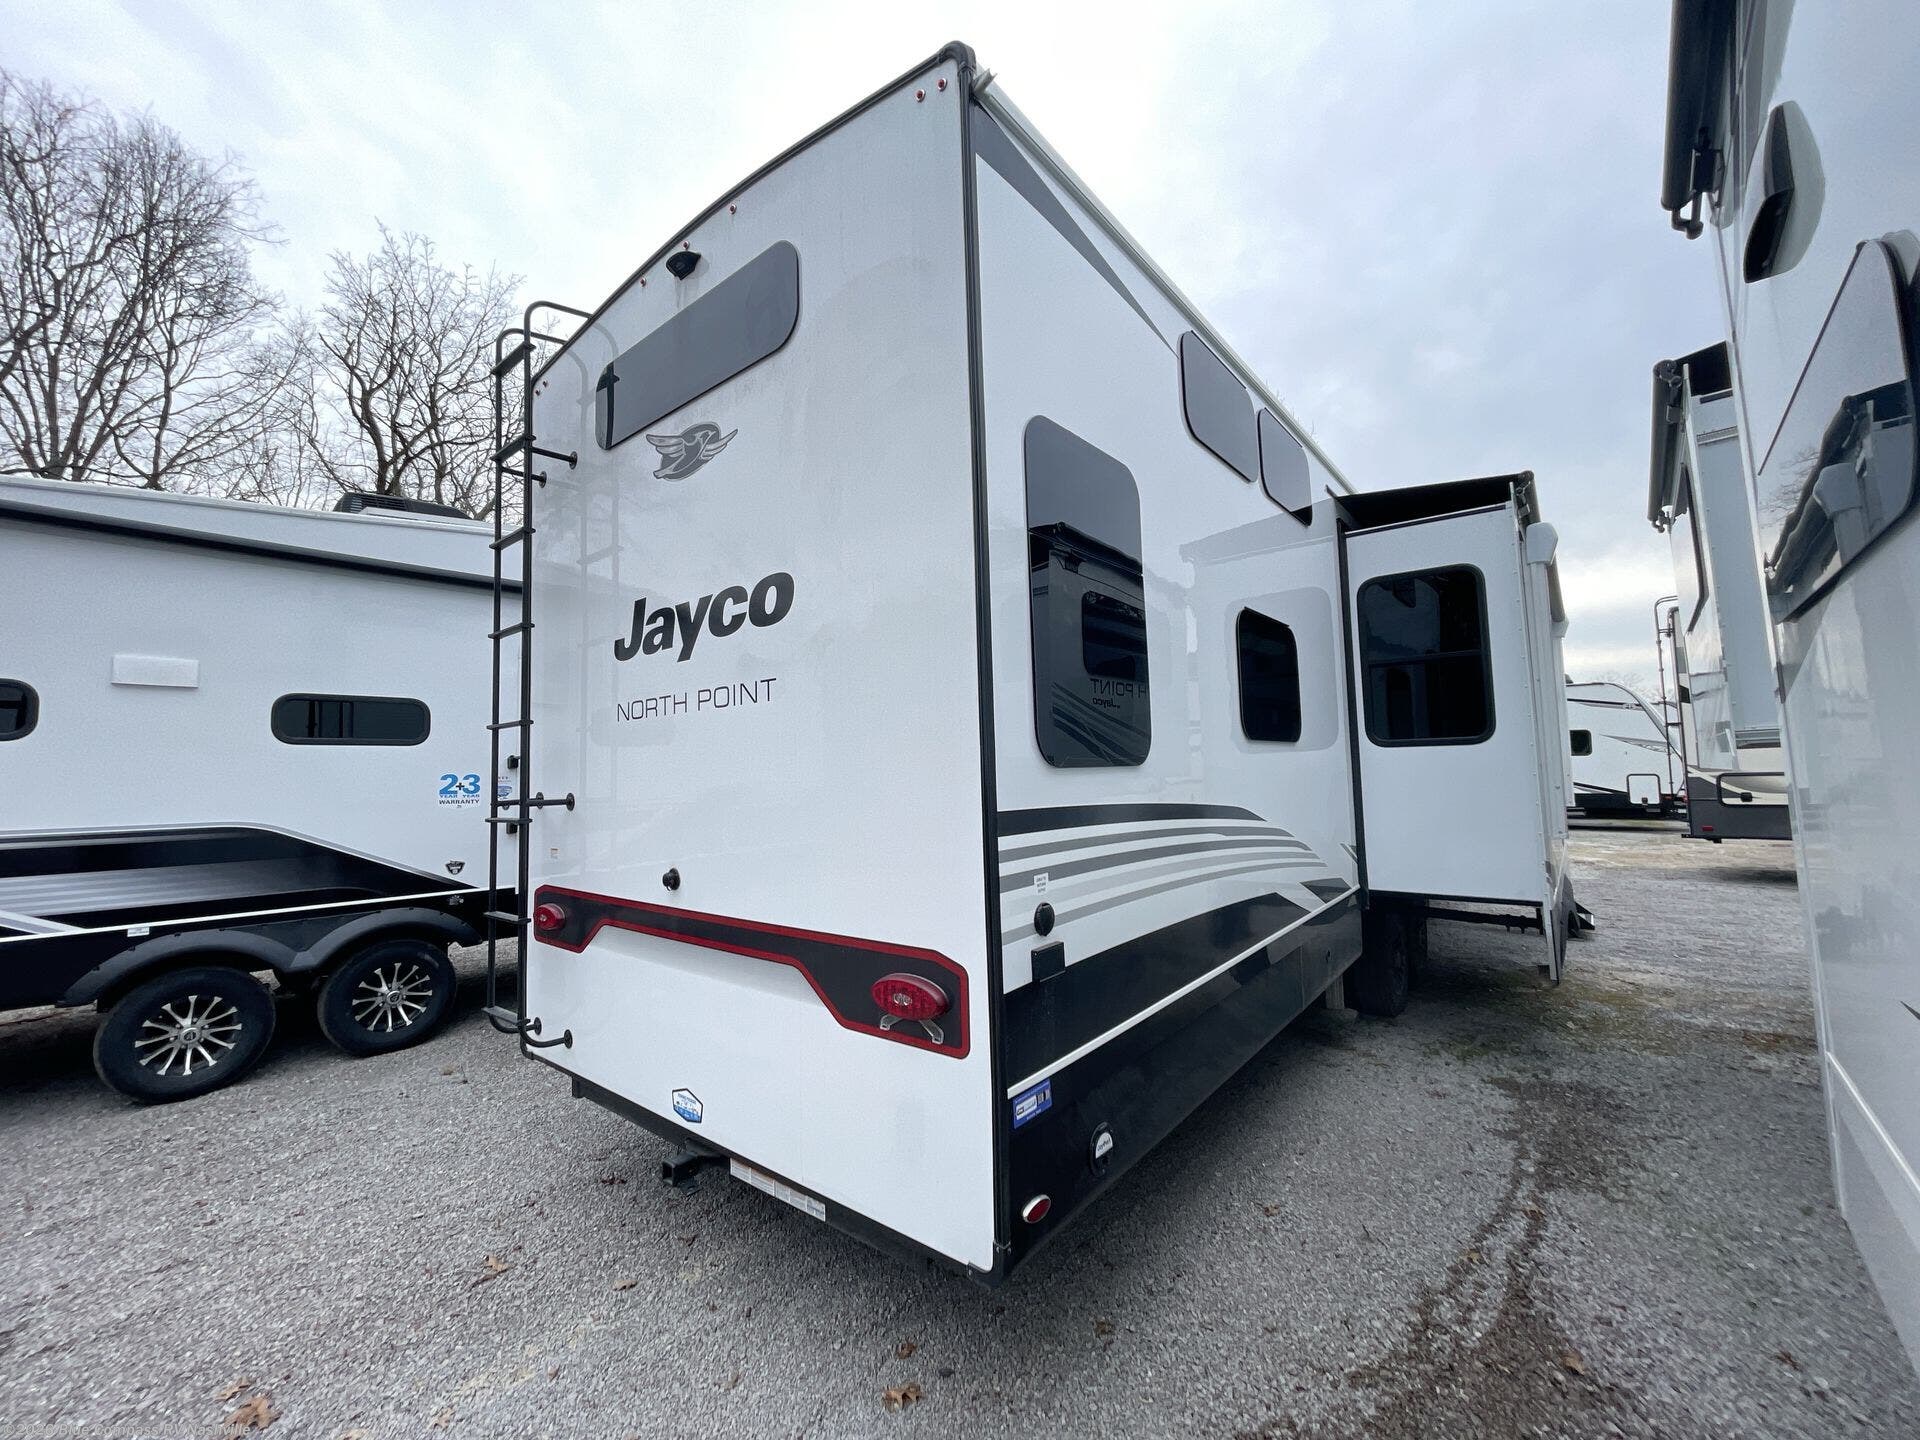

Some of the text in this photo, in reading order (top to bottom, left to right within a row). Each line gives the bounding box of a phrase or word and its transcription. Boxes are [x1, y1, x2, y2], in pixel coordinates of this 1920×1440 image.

[614, 572, 795, 662] Jayco
[617, 678, 777, 722] NORTH POINT
